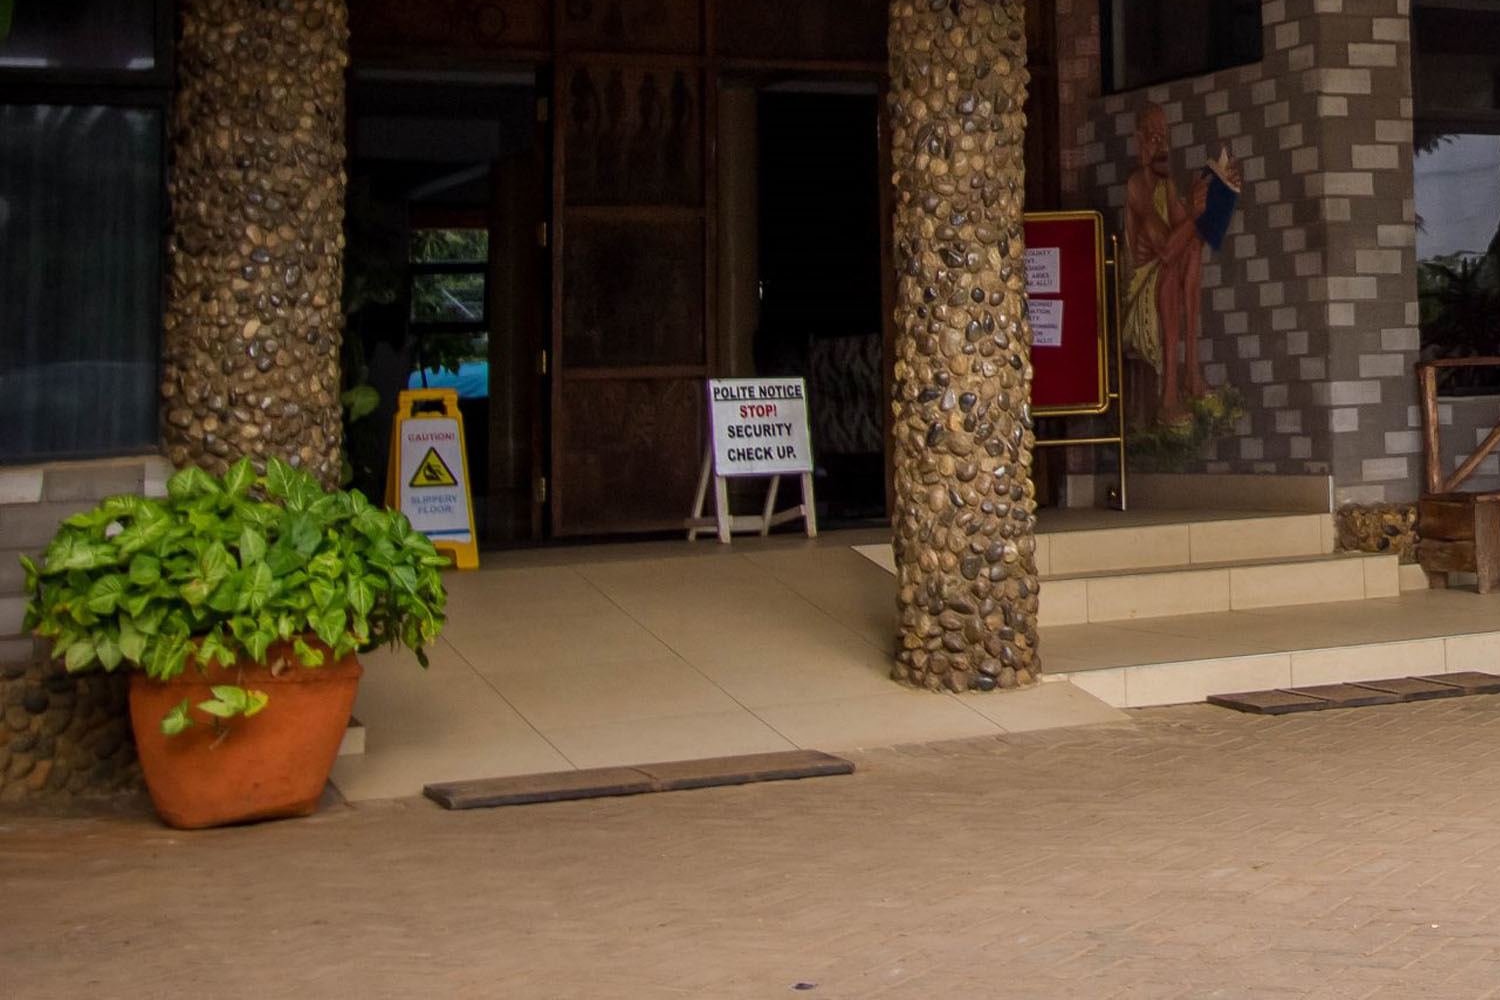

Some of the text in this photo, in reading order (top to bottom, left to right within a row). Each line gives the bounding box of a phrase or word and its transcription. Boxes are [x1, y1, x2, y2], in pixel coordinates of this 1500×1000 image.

[713, 385, 802, 399] POLITE NOTICE
[740, 404, 777, 419] STOP!
[408, 431, 455, 442] CAUTION!
[727, 423, 792, 438] SECURITY
[727, 446, 773, 461] CHECK
[411, 495, 457, 504] SLIPPERY
[418, 505, 452, 514] FLOOR
